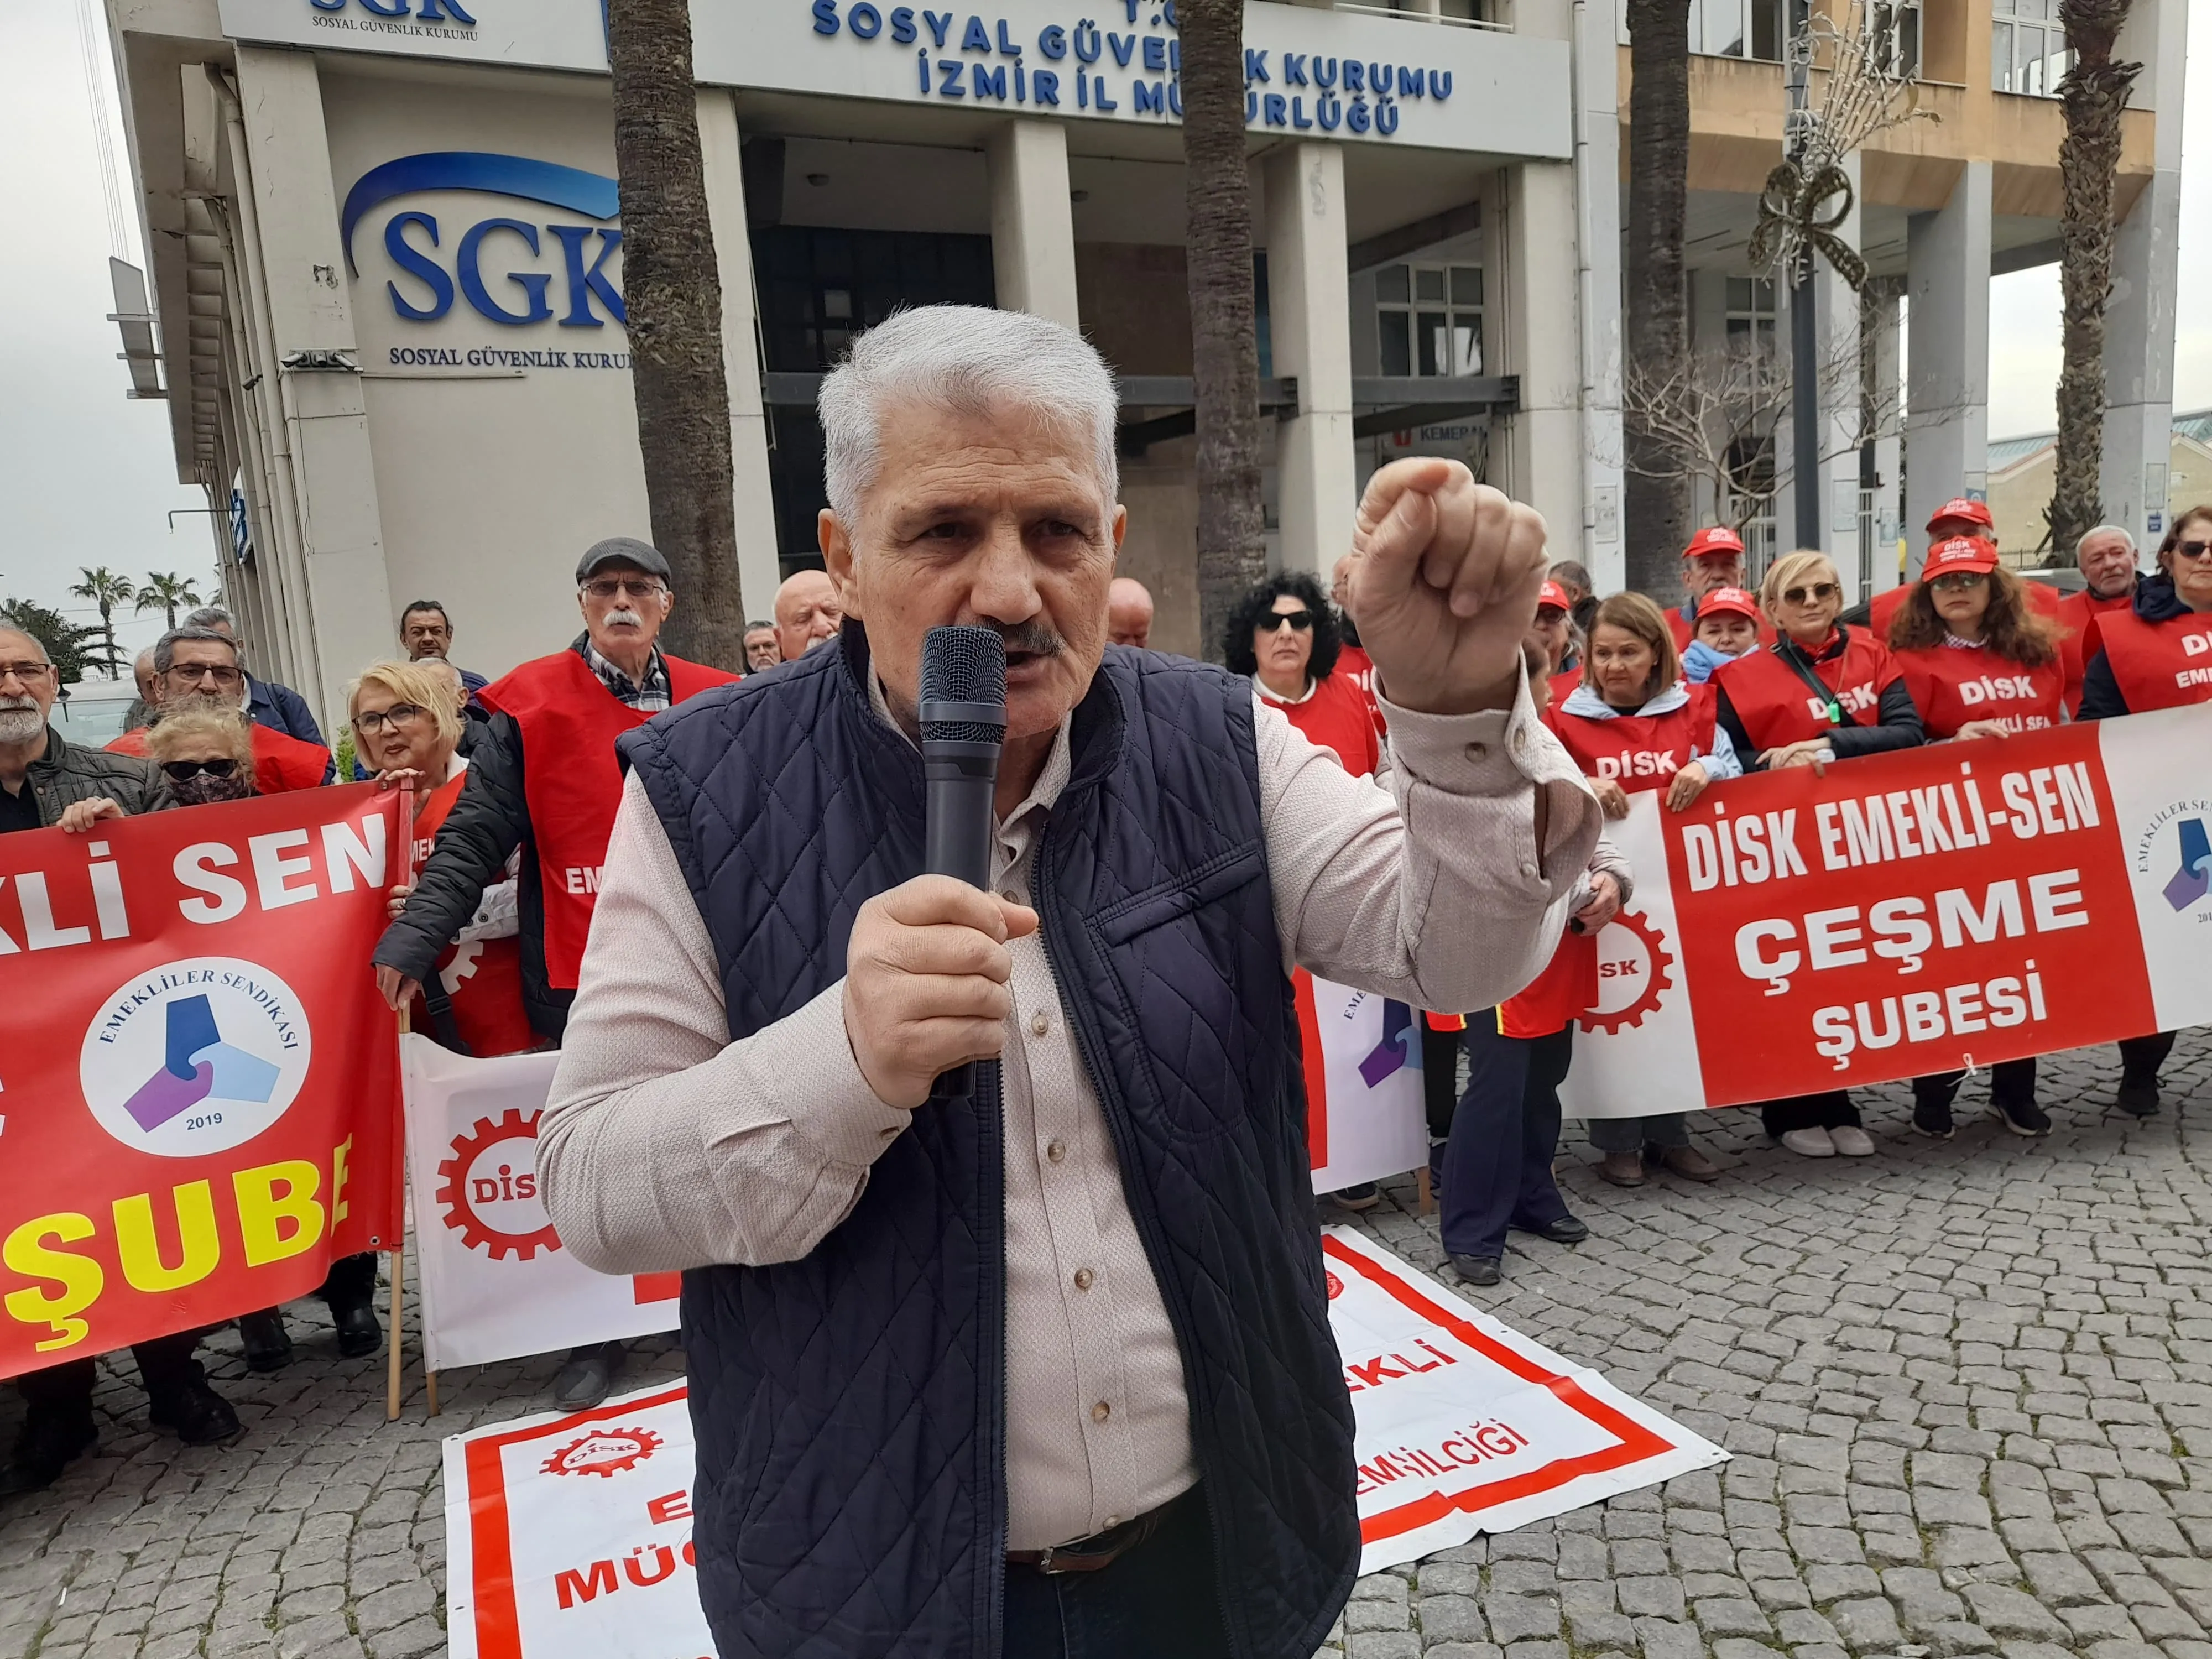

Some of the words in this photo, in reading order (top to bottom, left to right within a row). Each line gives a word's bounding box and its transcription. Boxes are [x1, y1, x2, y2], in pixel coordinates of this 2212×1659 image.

[312, 15, 358, 30] SOSYAL
[360, 18, 423, 36] GÜVENLİK
[426, 27, 478, 41] KURUMU
[812, 0, 1021, 55] SOSYAL
[1284, 53, 1453, 101] KURUMU
[919, 48, 1060, 105] İZMİR
[1077, 65, 1118, 111] İL
[384, 211, 627, 327] SGK
[389, 347, 463, 366] SOSYAL
[467, 346, 570, 368] GÜVENLİK
[573, 352, 635, 369] KURU
[1806, 680, 1879, 720] DSK
[1958, 675, 2038, 706] DİSK
[1596, 749, 1679, 781] DİSK
[1682, 801, 1808, 893] DİSK
[1814, 761, 2100, 871] EMEKLİ-SEN
[2138, 801, 2188, 873] EMEKLİLER
[173, 813, 386, 925] SEN
[1734, 868, 2090, 996] ÇEŞME
[99, 969, 215, 1044] EMEKLİLER
[220, 971, 299, 1051] SENDİKASI
[1812, 959, 2047, 1071] ŞUBESİ
[186, 1112, 223, 1131] 2019
[567, 1443, 638, 1465] DİSK
